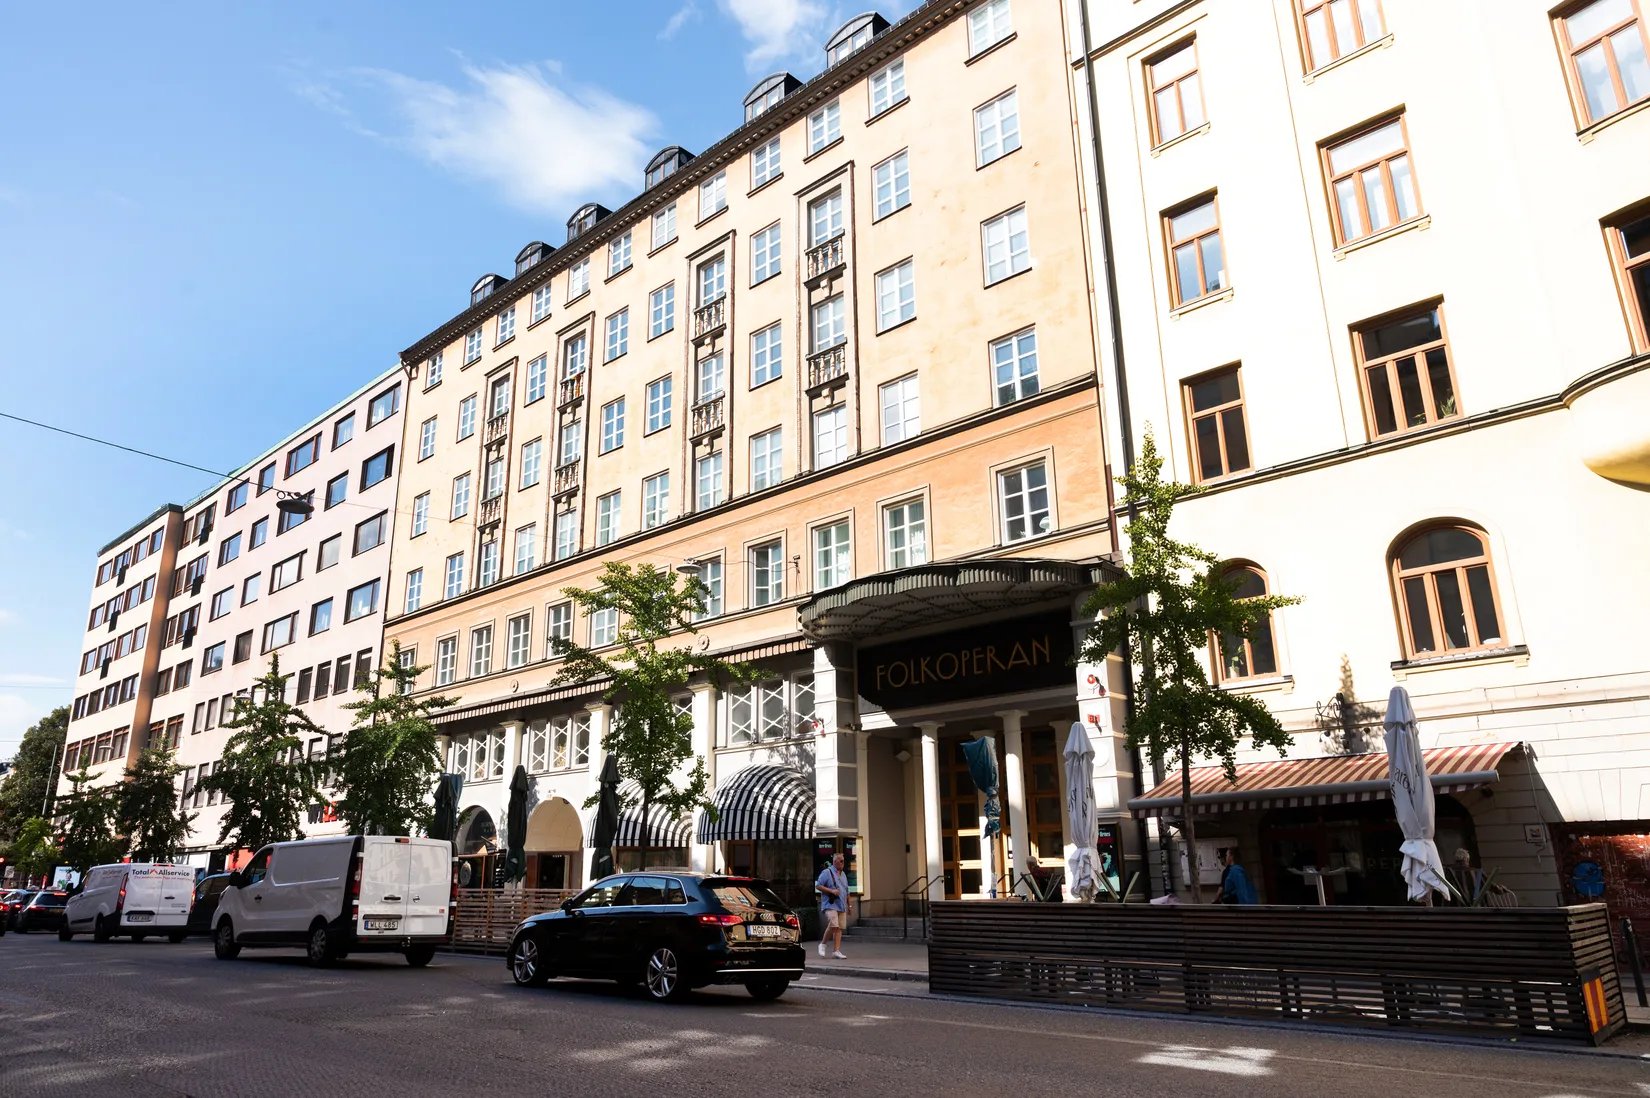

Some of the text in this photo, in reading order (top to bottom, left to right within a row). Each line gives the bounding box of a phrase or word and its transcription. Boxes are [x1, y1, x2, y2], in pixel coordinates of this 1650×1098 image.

[876, 634, 1051, 691] FOLKOPERAN
[158, 869, 190, 877] Allservice
[752, 925, 765, 934] HGD
